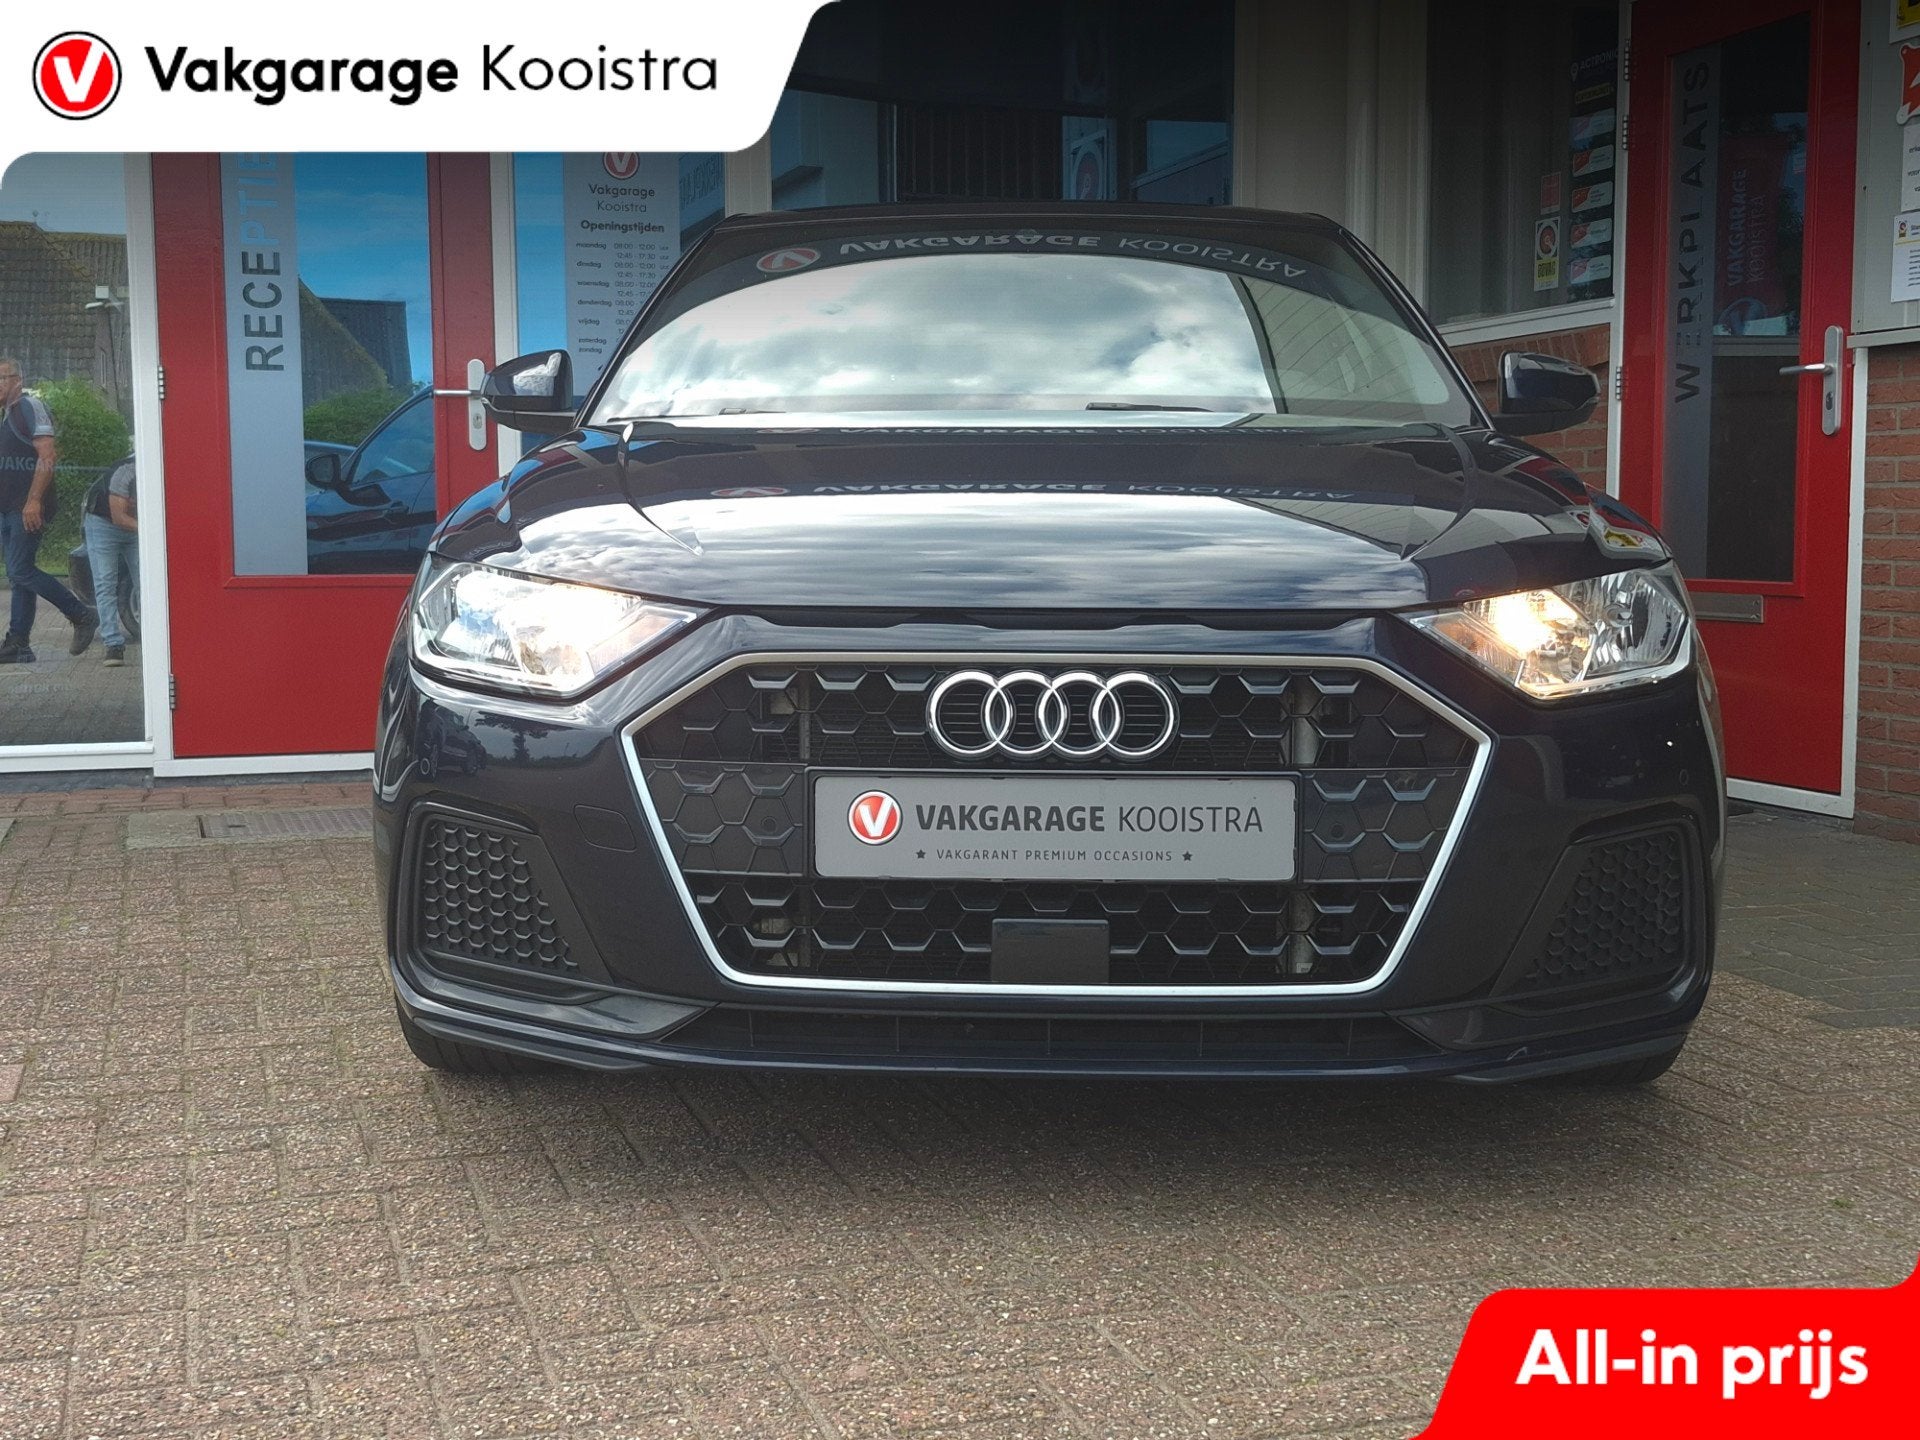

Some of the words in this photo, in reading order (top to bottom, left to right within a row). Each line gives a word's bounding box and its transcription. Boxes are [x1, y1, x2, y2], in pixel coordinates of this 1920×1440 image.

[588, 183, 656, 199] Vakgarage
[597, 200, 647, 213] Kooistra
[580, 219, 665, 235] Openingstijden
[1675, 62, 1710, 403] WERKPLAATS
[915, 804, 1106, 832] VAKGARAGE
[1118, 806, 1264, 833] KOOISTRA
[936, 848, 1018, 862] VAKGARANT
[1025, 849, 1087, 862] PREMIUM
[1093, 850, 1173, 863] OCCASIONS
